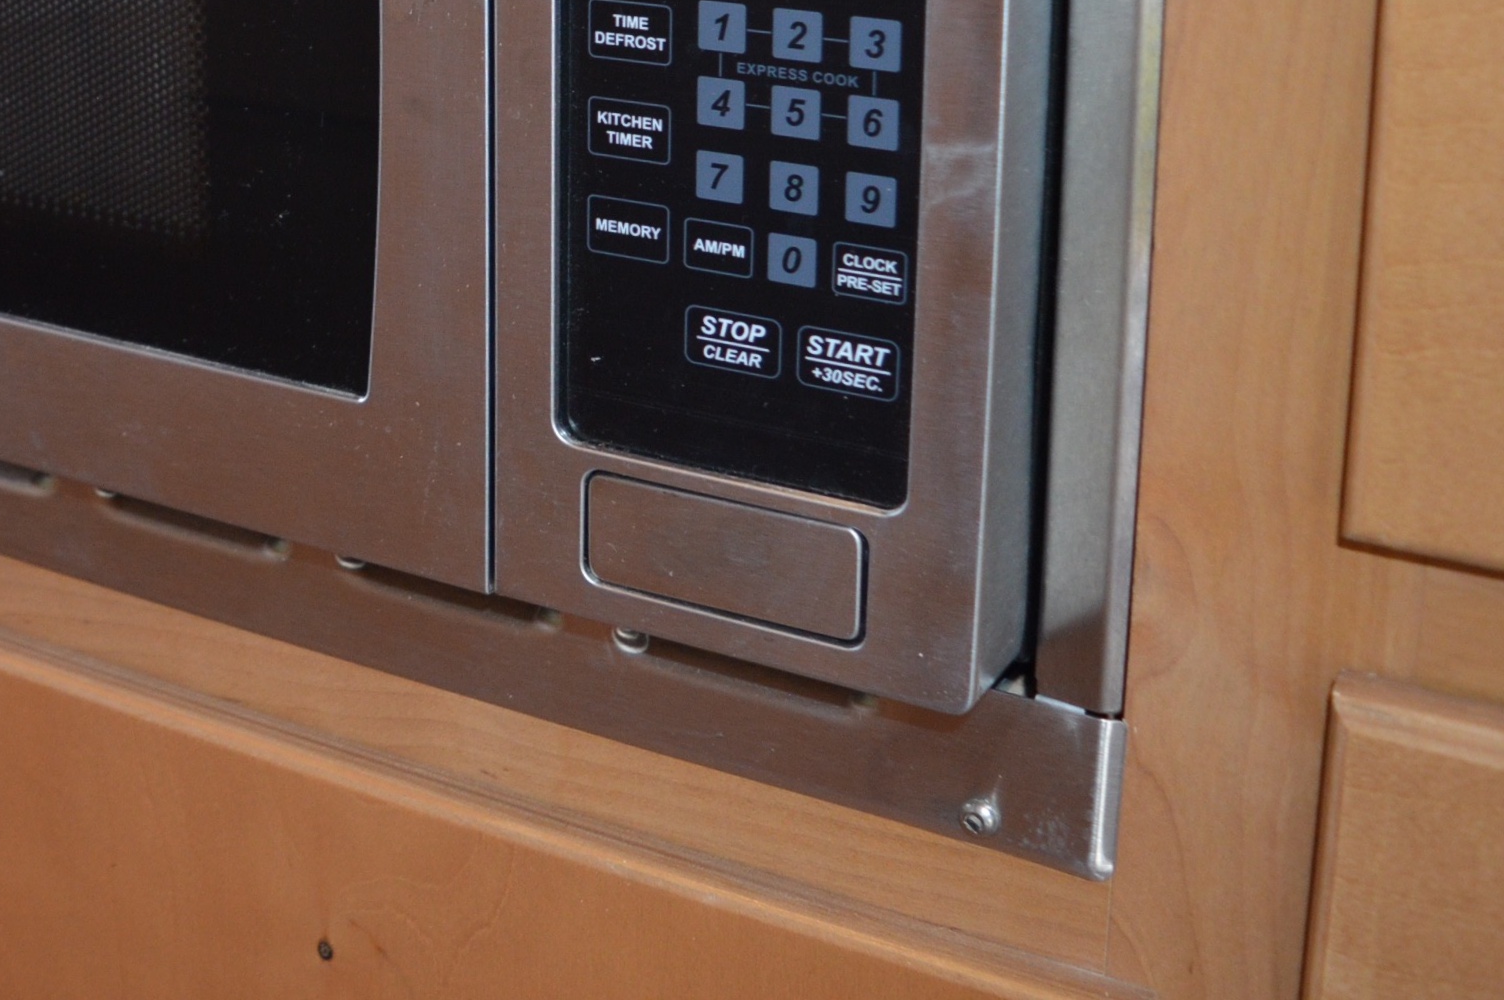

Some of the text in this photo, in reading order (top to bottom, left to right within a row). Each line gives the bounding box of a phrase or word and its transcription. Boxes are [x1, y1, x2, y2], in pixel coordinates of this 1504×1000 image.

[612, 13, 649, 30] TIME
[713, 13, 730, 41] 1
[594, 31, 666, 51] DEFROST
[787, 21, 808, 50] 2
[864, 29, 886, 59] 3
[736, 62, 859, 89] EXPRESS COOK
[711, 90, 731, 117] 4
[785, 98, 806, 127] 5
[597, 110, 663, 132] KITCHEN
[862, 108, 883, 137] 6
[606, 131, 653, 149] TIMER
[710, 163, 729, 190] 7
[784, 174, 804, 203] 8
[860, 185, 881, 214] 9
[595, 218, 661, 240] MEMORY
[693, 238, 745, 259] AM/PM
[781, 246, 802, 274] 0
[842, 253, 898, 274] CLOCK
[837, 275, 902, 297] PRE-SET
[700, 315, 767, 343] STOP
[702, 345, 763, 369] CLEAR
[806, 335, 891, 368] START
[811, 367, 883, 392] +30SEC.
